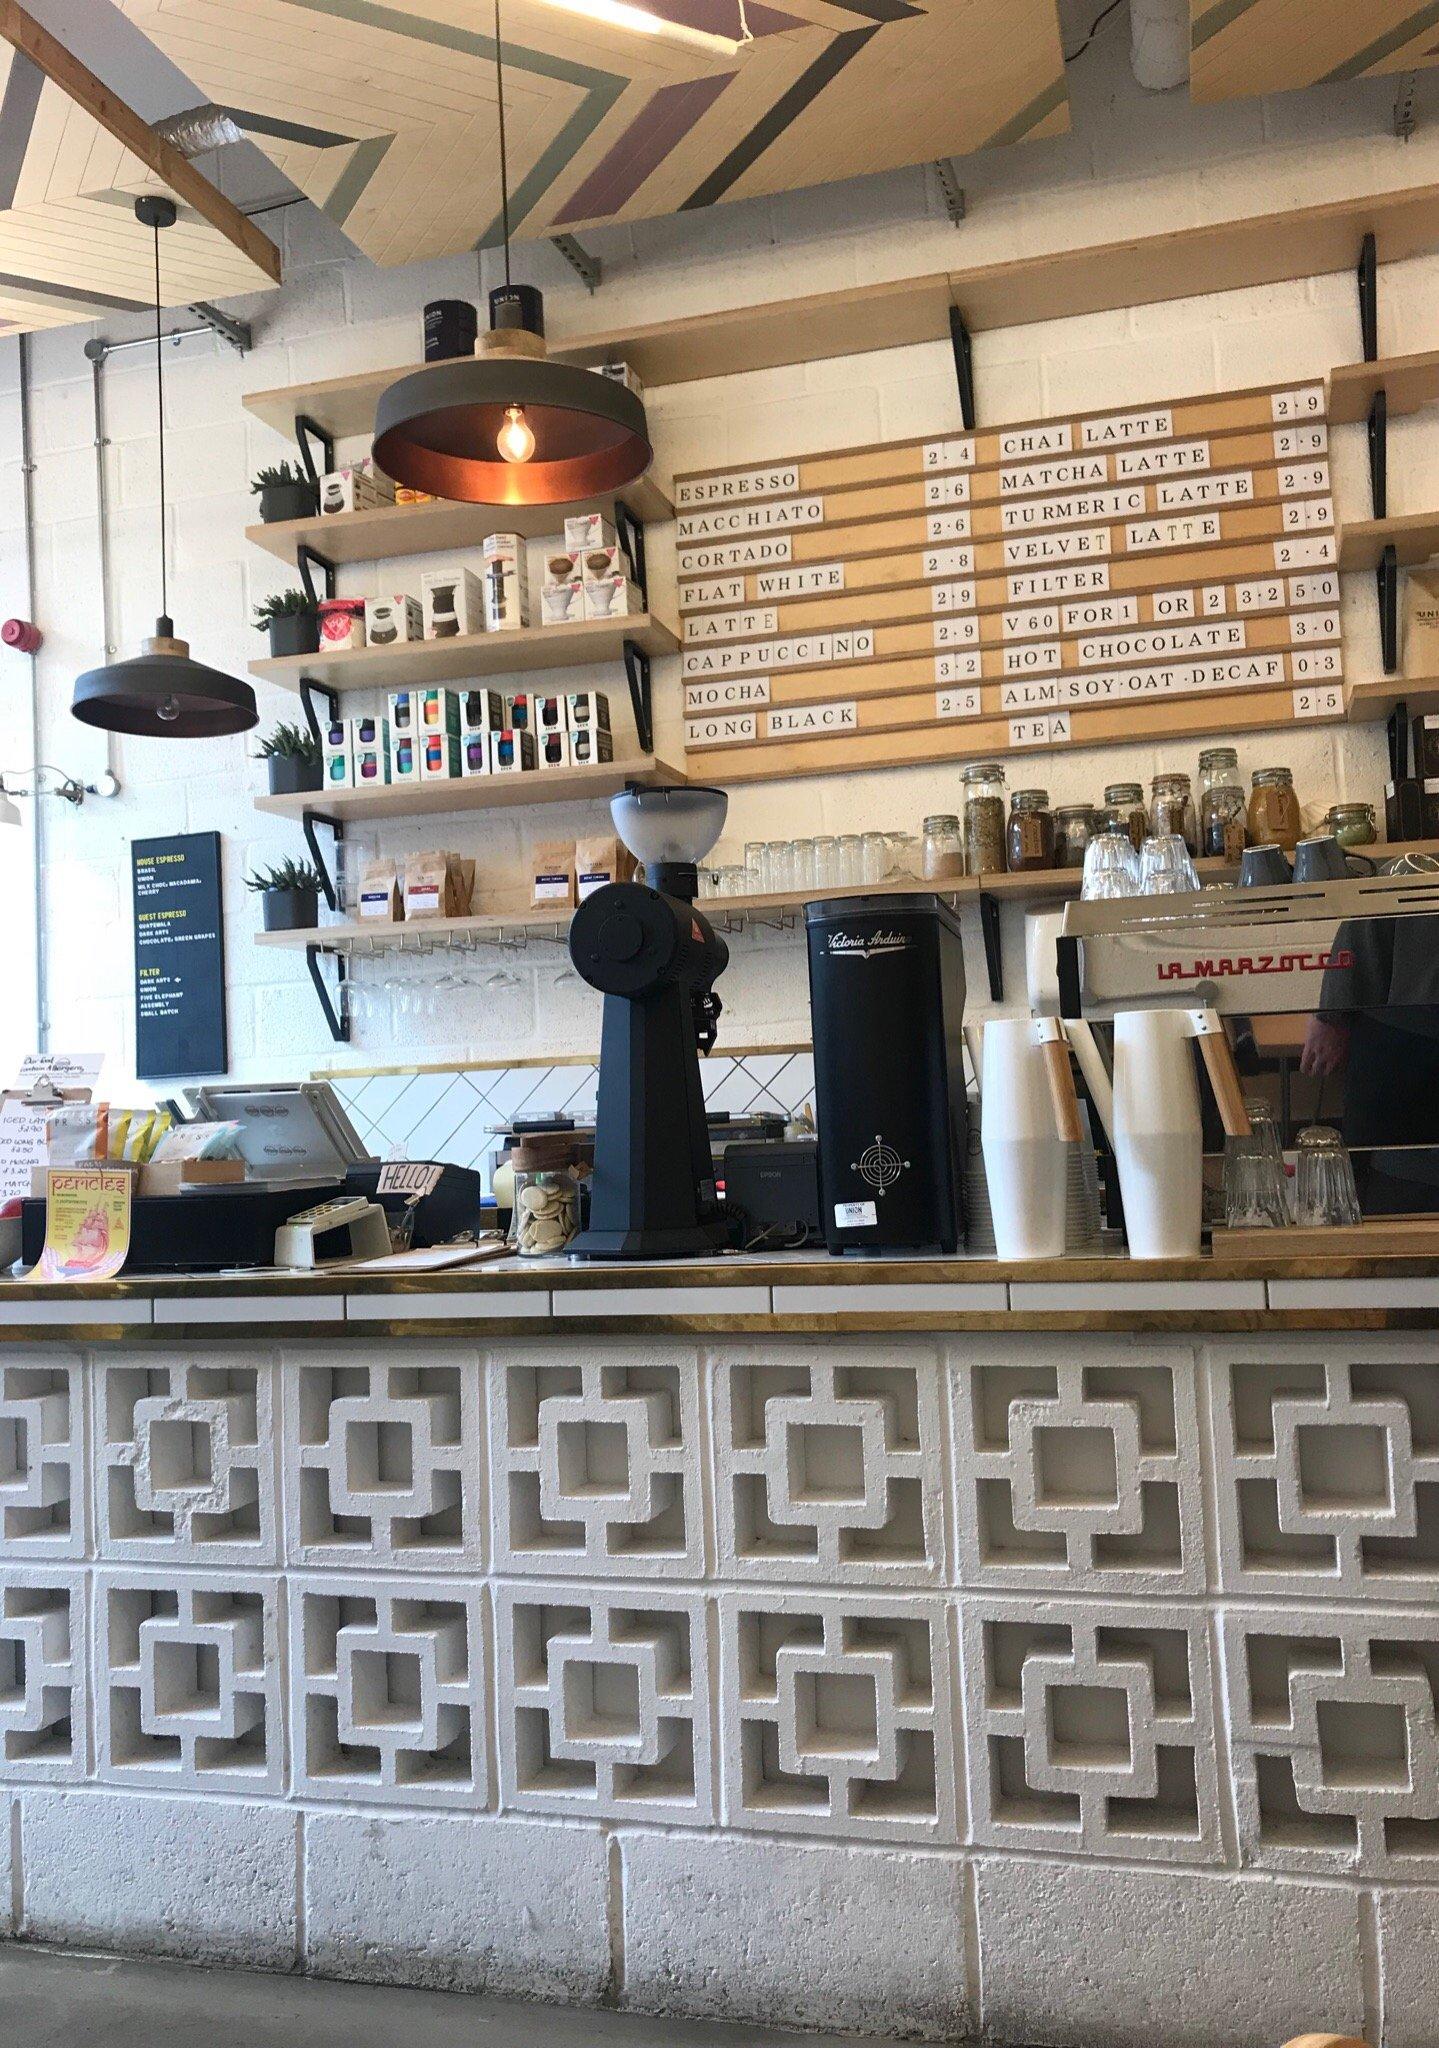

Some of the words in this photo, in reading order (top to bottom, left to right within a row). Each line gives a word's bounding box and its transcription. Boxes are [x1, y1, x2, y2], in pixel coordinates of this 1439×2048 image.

[1004, 432, 1063, 454] CHAI
[1086, 417, 1168, 442] LATTE
[1001, 463, 1103, 490] MATCHA
[1121, 448, 1205, 473] LATTE
[679, 473, 795, 503] ESPRESSO
[1005, 493, 1145, 526] TURMERIC
[1161, 479, 1248, 504] LATTE
[678, 505, 820, 537] MACCHIATO
[1007, 534, 1105, 560] VELVET
[1131, 520, 1215, 544] LATTE
[681, 543, 788, 570] CORTADO
[683, 583, 741, 603] FLAT
[759, 570, 840, 593] WHITE
[1013, 571, 1104, 596] FILTER
[1157, 598, 1189, 615] OR
[1209, 594, 1219, 608] 2
[688, 616, 771, 637] LATTE
[686, 636, 870, 672] CAPPUCCINO
[1008, 649, 1057, 669] HOT
[1082, 626, 1240, 659] CHOCOLATE
[688, 684, 766, 705] MOCHA
[689, 719, 752, 739] LONG
[772, 708, 853, 730] BLACK
[1013, 719, 1066, 739] TEA
[136, 857, 154, 866] HOUSE
[156, 854, 186, 865] ESPRESSO
[138, 913, 157, 921] GUEST
[158, 910, 187, 920] ESPRESSO
[828, 932, 865, 948] Victoria
[140, 968, 160, 977] FILTER
[1157, 962, 1180, 980] LA
[1194, 950, 1354, 979] MARZOCCO
[382, 1164, 436, 1189] HELLO!
